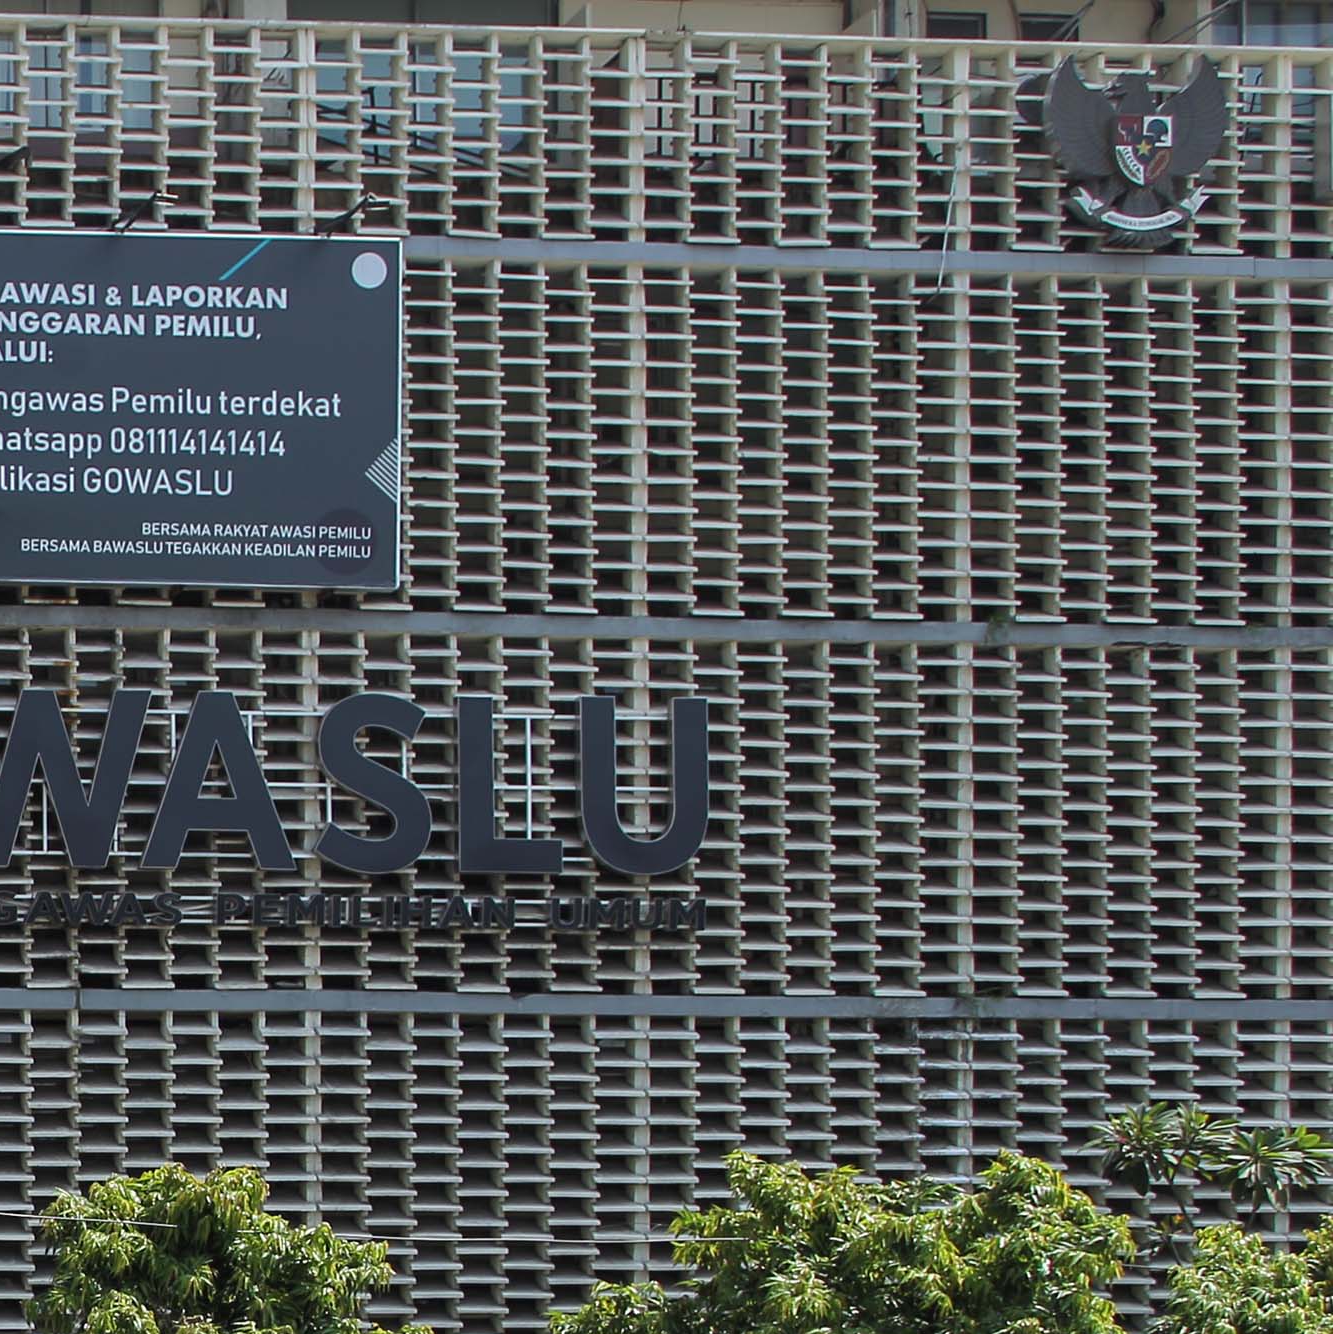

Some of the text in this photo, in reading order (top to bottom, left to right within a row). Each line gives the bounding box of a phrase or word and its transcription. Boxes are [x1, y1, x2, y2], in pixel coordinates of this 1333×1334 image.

[0, 283, 96, 306] AWASI
[104, 283, 122, 307] &
[131, 285, 288, 310] LAPORKAN
[155, 314, 262, 341] PEMILU,
[112, 387, 212, 415] Pemilu
[219, 389, 342, 418] terdekat
[110, 427, 286, 457] 081114141414
[82, 467, 234, 496] GOWASLU
[141, 522, 372, 540] BERSAMA RAKYAT AWASI PEMILU
[20, 538, 372, 559] BERSAMA BAWASLU TEGAKKAN KEADILAN PEMILU
[213, 892, 517, 931] PEMILIHAN
[547, 896, 708, 933] UMUM
